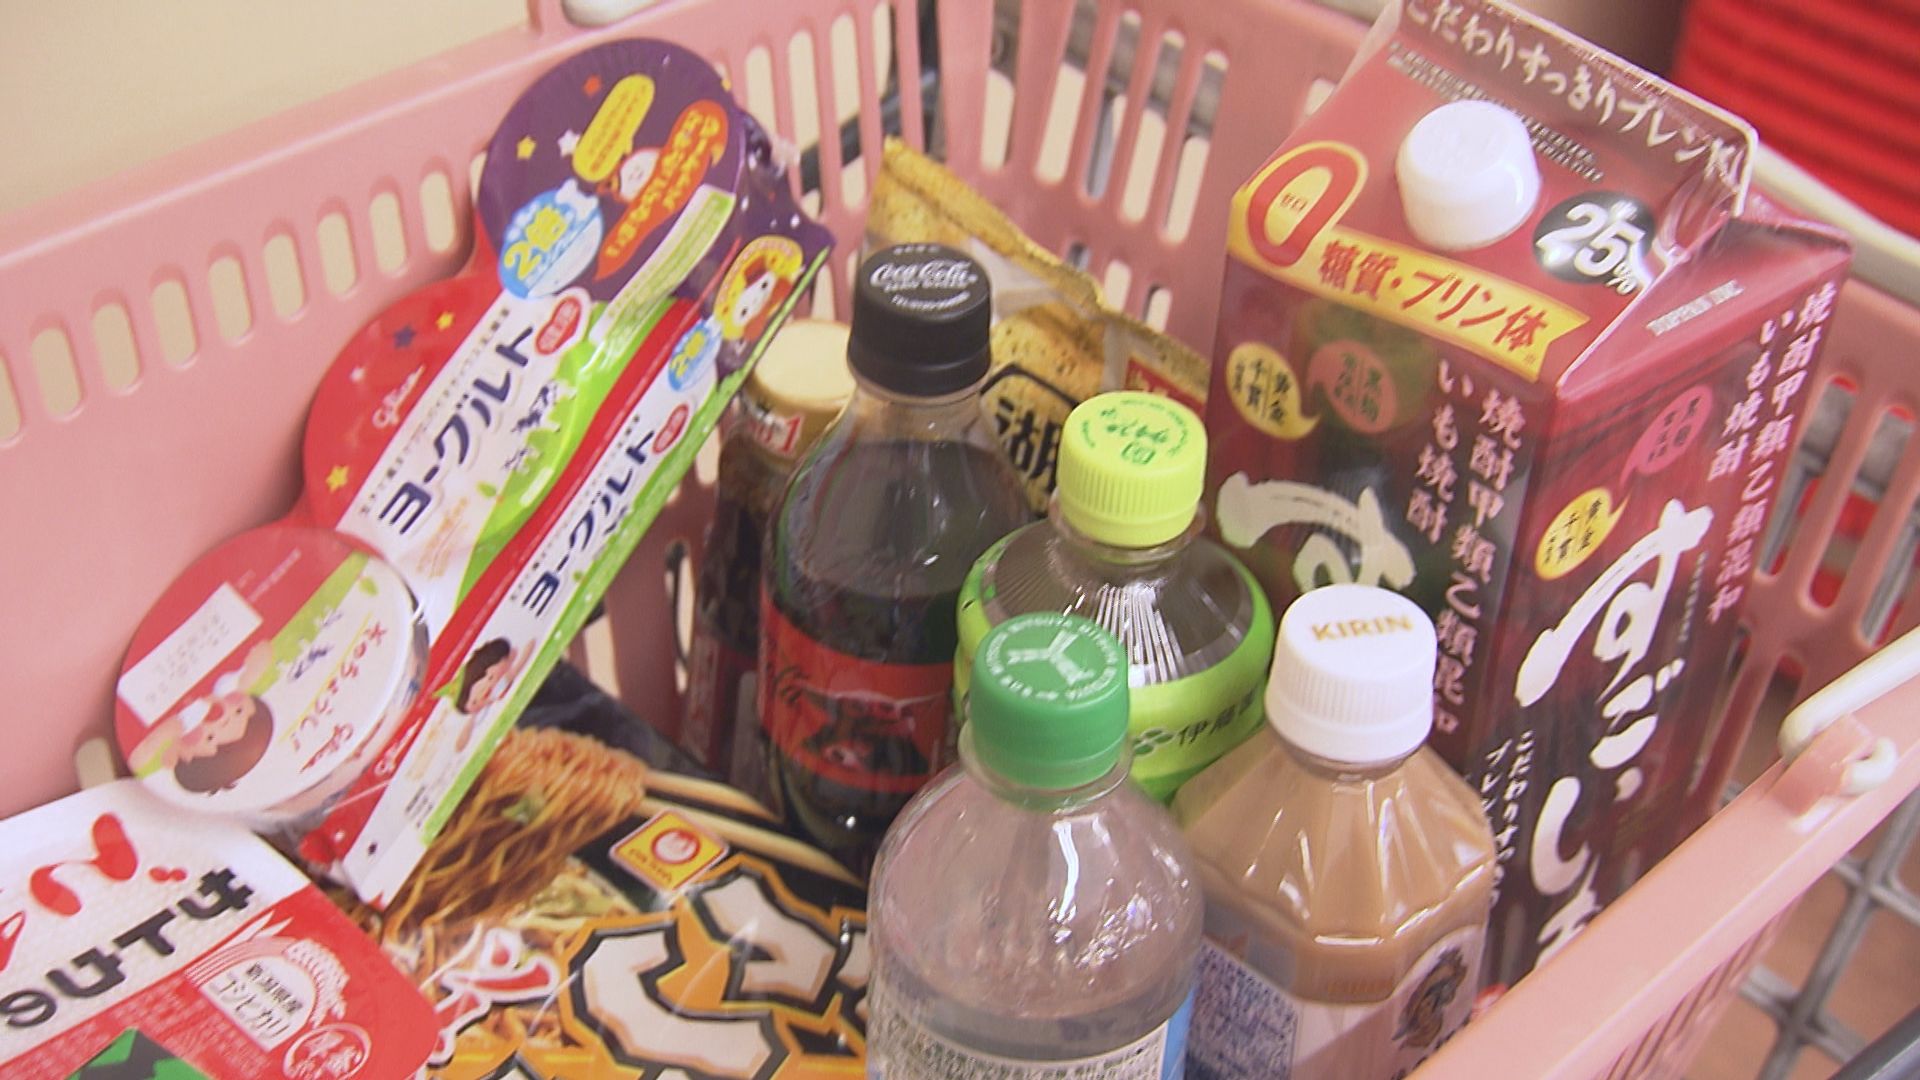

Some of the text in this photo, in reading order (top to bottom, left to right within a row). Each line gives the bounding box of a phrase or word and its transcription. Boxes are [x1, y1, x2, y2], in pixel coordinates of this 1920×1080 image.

[868, 258, 979, 290] Coca-Cola
[1536, 202, 1640, 297] 25%
[378, 326, 533, 535] ヨーグルト
[1406, 358, 1475, 544] いも焼酎
[1707, 310, 1795, 482] いも焼酎
[522, 430, 655, 618] ヨーグルト
[1312, 615, 1413, 642] KIRIN
